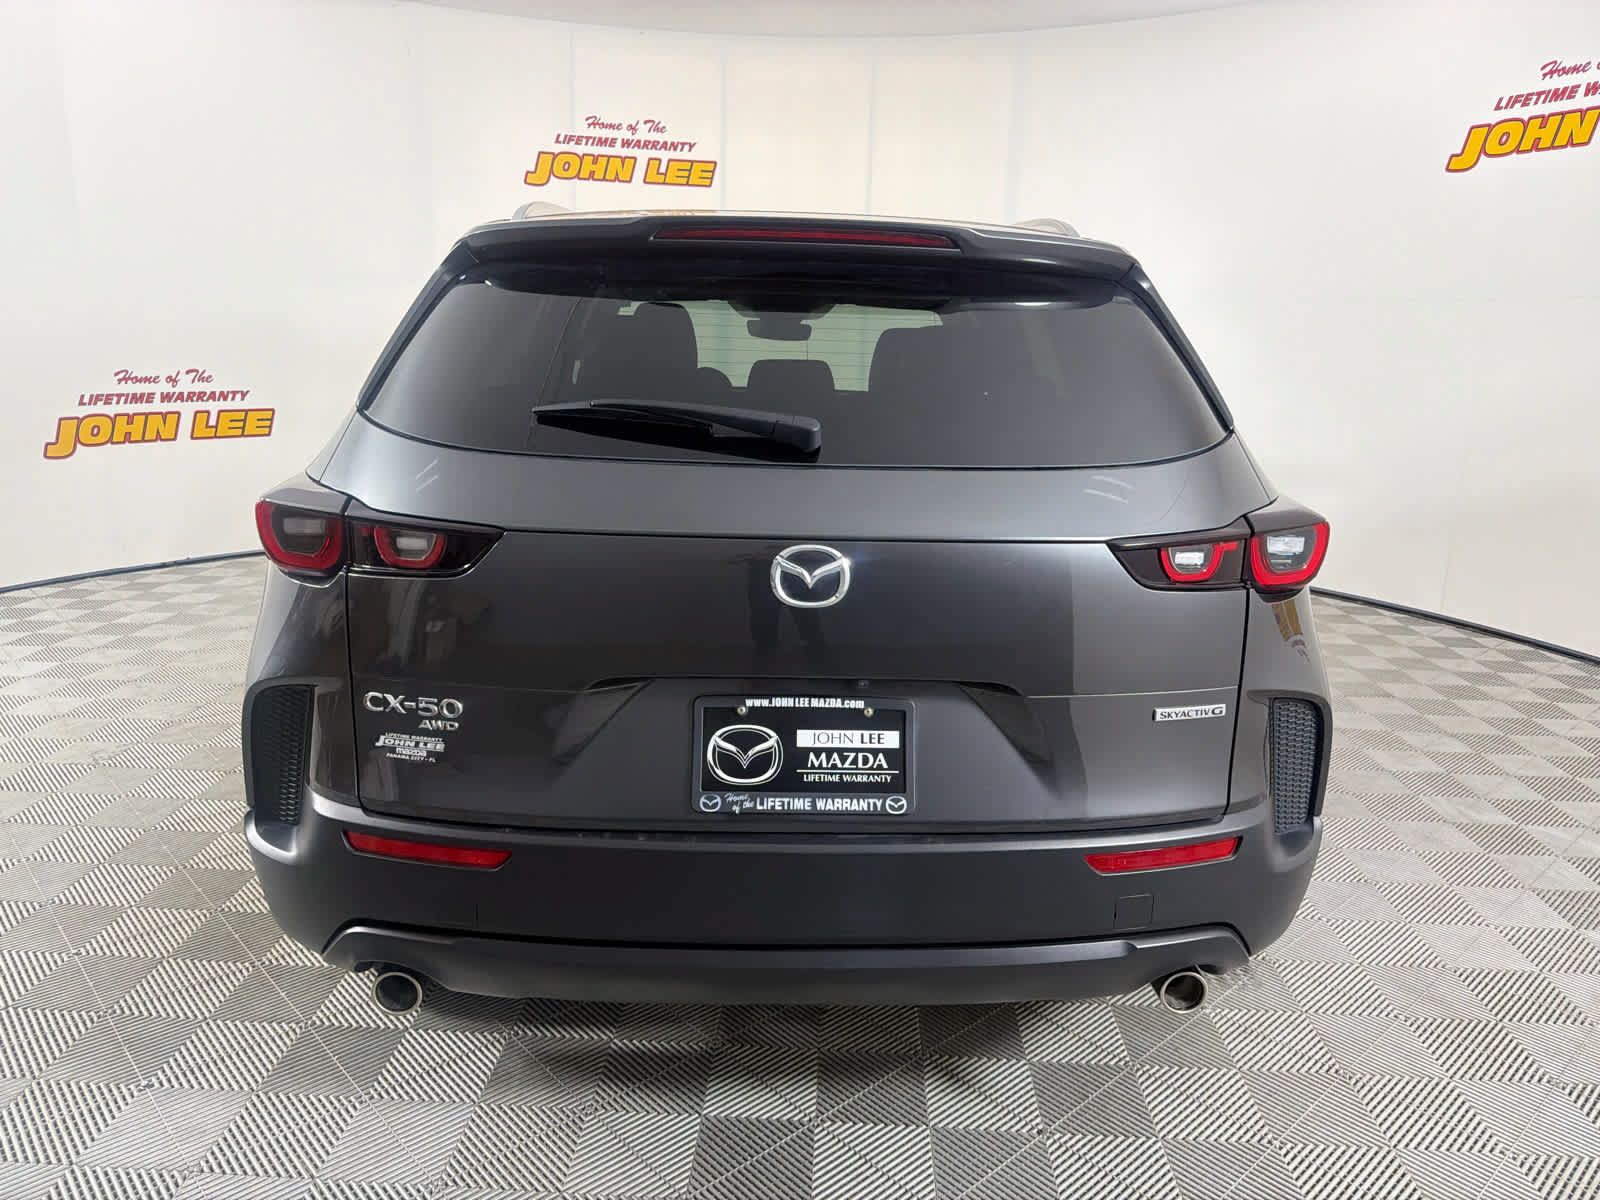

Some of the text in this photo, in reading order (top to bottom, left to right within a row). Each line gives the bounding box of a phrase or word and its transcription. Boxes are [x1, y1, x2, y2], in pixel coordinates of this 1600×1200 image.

[1540, 60, 1592, 80] Home
[1494, 84, 1581, 111] LIFETIME
[585, 115, 668, 135] Home of The
[554, 133, 697, 152] LIFETIME WARRANTY
[1446, 105, 1600, 172] JOHN
[524, 151, 717, 187] JOHN LEE
[114, 368, 215, 388] Home of The
[78, 390, 250, 406] LIFETIME WARRANTY
[43, 408, 276, 460] JOHN LEE
[363, 691, 464, 719] CX-50
[795, 698, 810, 707] LEE
[418, 719, 459, 731] AWD
[418, 743, 446, 752] LEE
[812, 734, 885, 745] JOHN LEE
[807, 752, 888, 769] MAZDA
[803, 774, 891, 783] LIFETIME WARRANTY
[756, 797, 882, 812] LIFETIME WARRANTY
